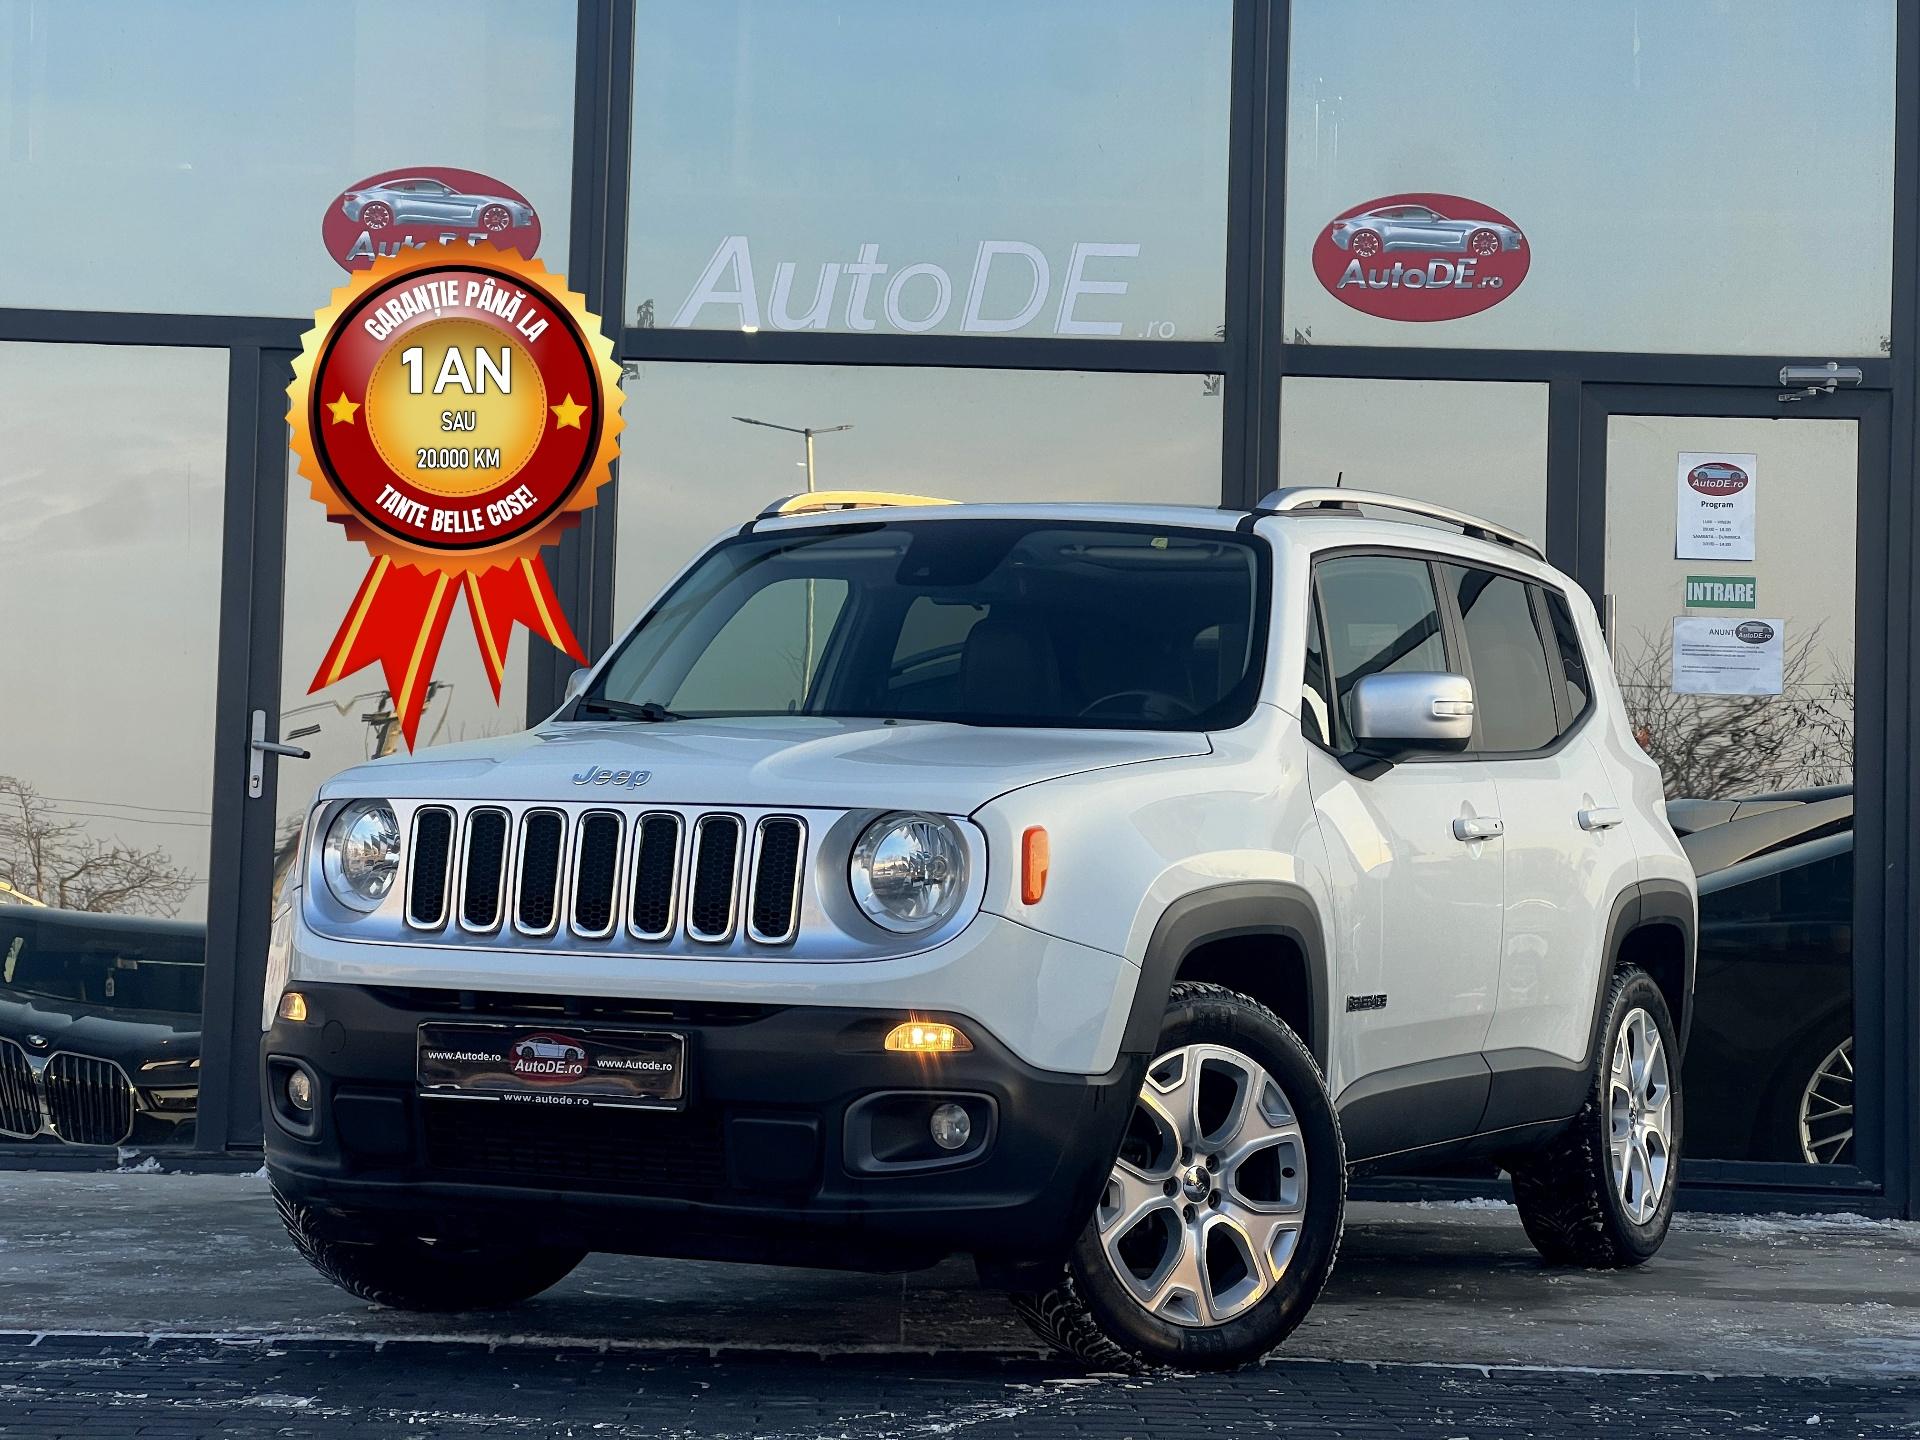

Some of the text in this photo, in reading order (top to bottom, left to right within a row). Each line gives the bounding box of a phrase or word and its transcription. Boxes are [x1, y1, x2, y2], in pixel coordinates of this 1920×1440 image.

[1692, 479, 1744, 488] AutoDE.ro
[1701, 501, 1734, 509] Program
[1687, 582, 1754, 602] INTRARE
[572, 765, 652, 790] Jeep
[428, 1050, 501, 1062] www.Autode.ro
[514, 1058, 583, 1075] AutoDE.ro
[596, 1058, 673, 1072] www.Autode.ro
[503, 1093, 590, 1106] www.autode.ro
